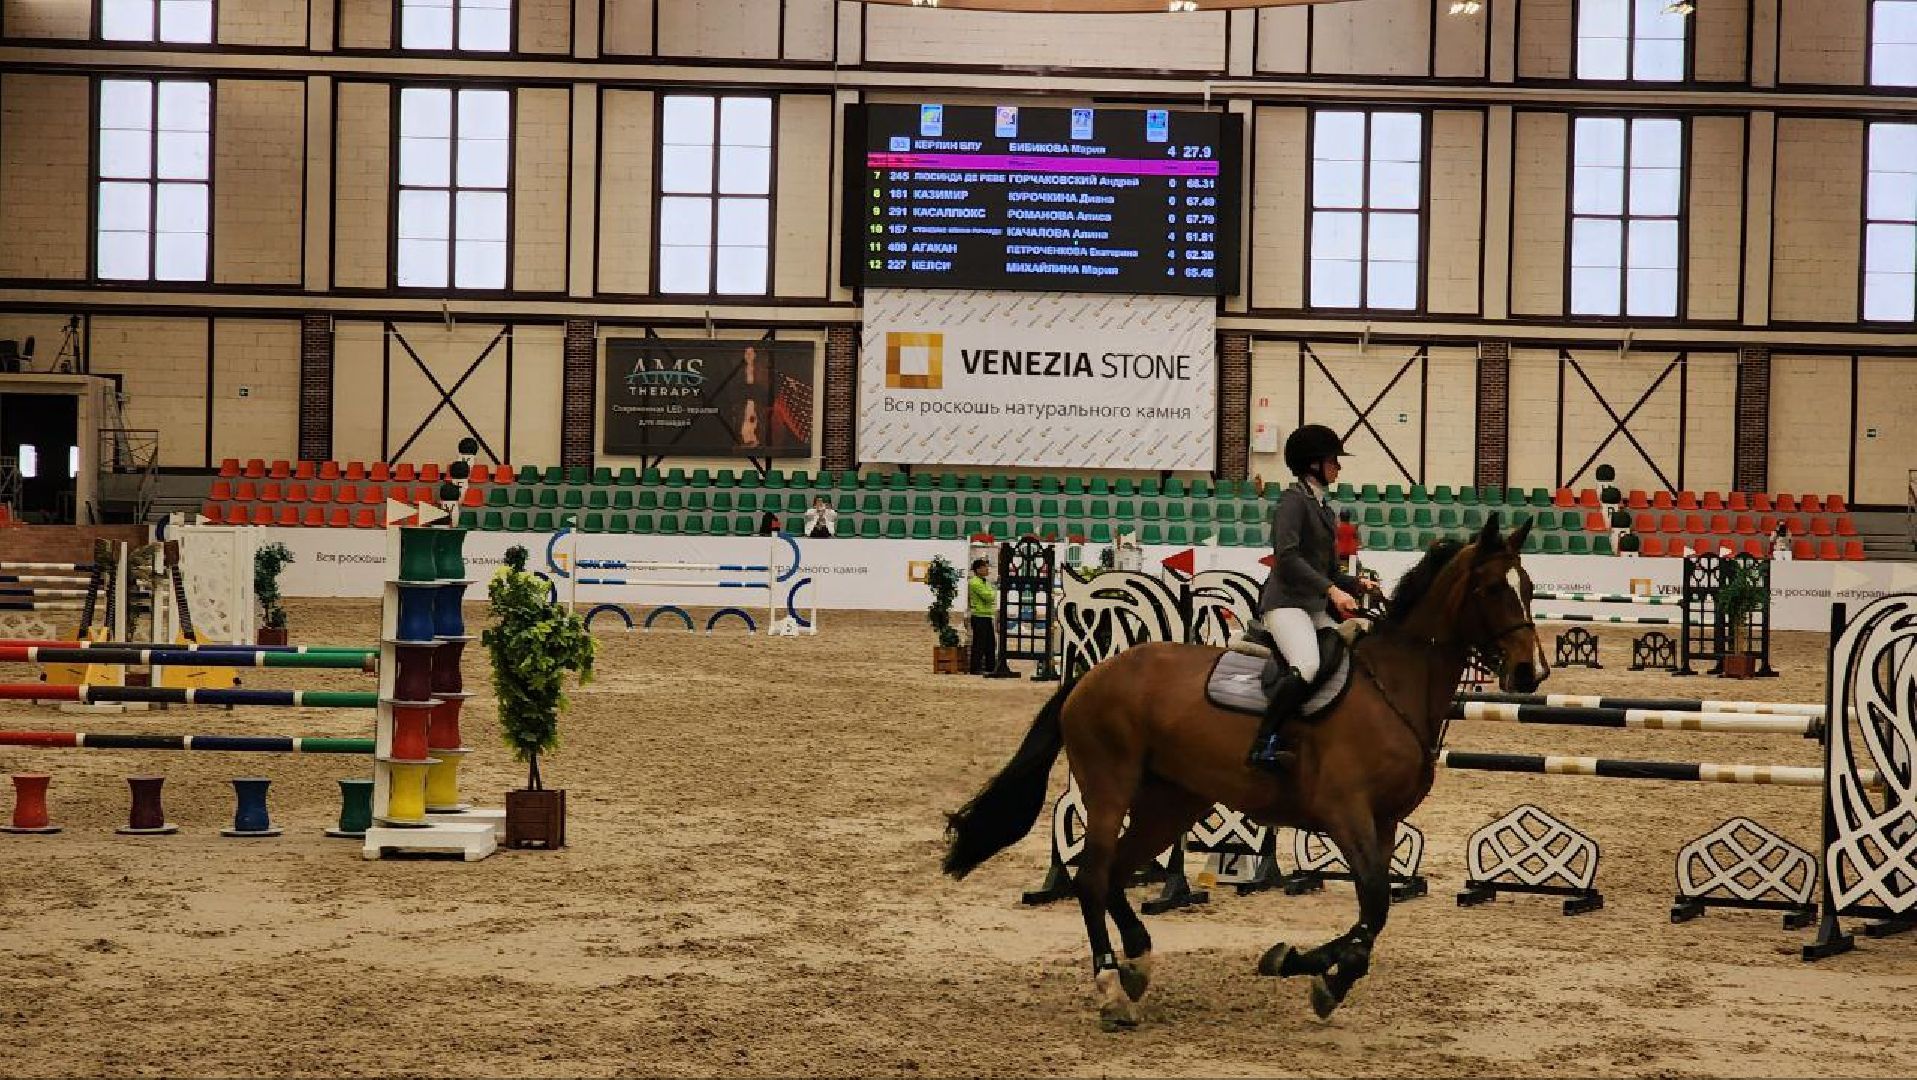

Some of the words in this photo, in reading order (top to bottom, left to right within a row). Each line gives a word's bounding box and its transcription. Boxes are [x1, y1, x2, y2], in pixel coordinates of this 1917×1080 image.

[1009, 142, 1068, 153] БИБИКОВА
[1167, 145, 1176, 157] 4
[1183, 146, 1211, 158] 27.9
[873, 172, 881, 180] 7
[1009, 172, 1097, 186] ГОРЧАКОВСКИЙ
[1168, 178, 1177, 188] 0
[913, 190, 968, 200] КАЗИМИР
[1008, 193, 1076, 203] КУРОЧКИНА
[1168, 196, 1176, 206] 0
[1007, 209, 1074, 220] РОМАНОВА
[1168, 213, 1176, 223] 0
[870, 224, 883, 234] 10
[1007, 227, 1070, 238] КАЧАЛОВА
[1073, 229, 1109, 239] Алина
[1167, 232, 1175, 242] 4
[869, 242, 881, 251] 11
[912, 243, 958, 253] АГАКАН
[1167, 250, 1175, 260] 4
[869, 260, 882, 269] 12
[887, 260, 907, 269] 227
[911, 260, 952, 270] КЕЛСИ
[627, 357, 704, 386] AMS
[961, 349, 1094, 378] VENEZIA
[1101, 352, 1191, 381] STONE
[628, 386, 701, 396] THERAPY
[884, 397, 914, 413] Вся
[920, 400, 1000, 417] роскошь
[1006, 402, 1131, 420] натурального
[1136, 405, 1191, 420] камня
[317, 551, 336, 562] Вся
[833, 566, 868, 575] камня
